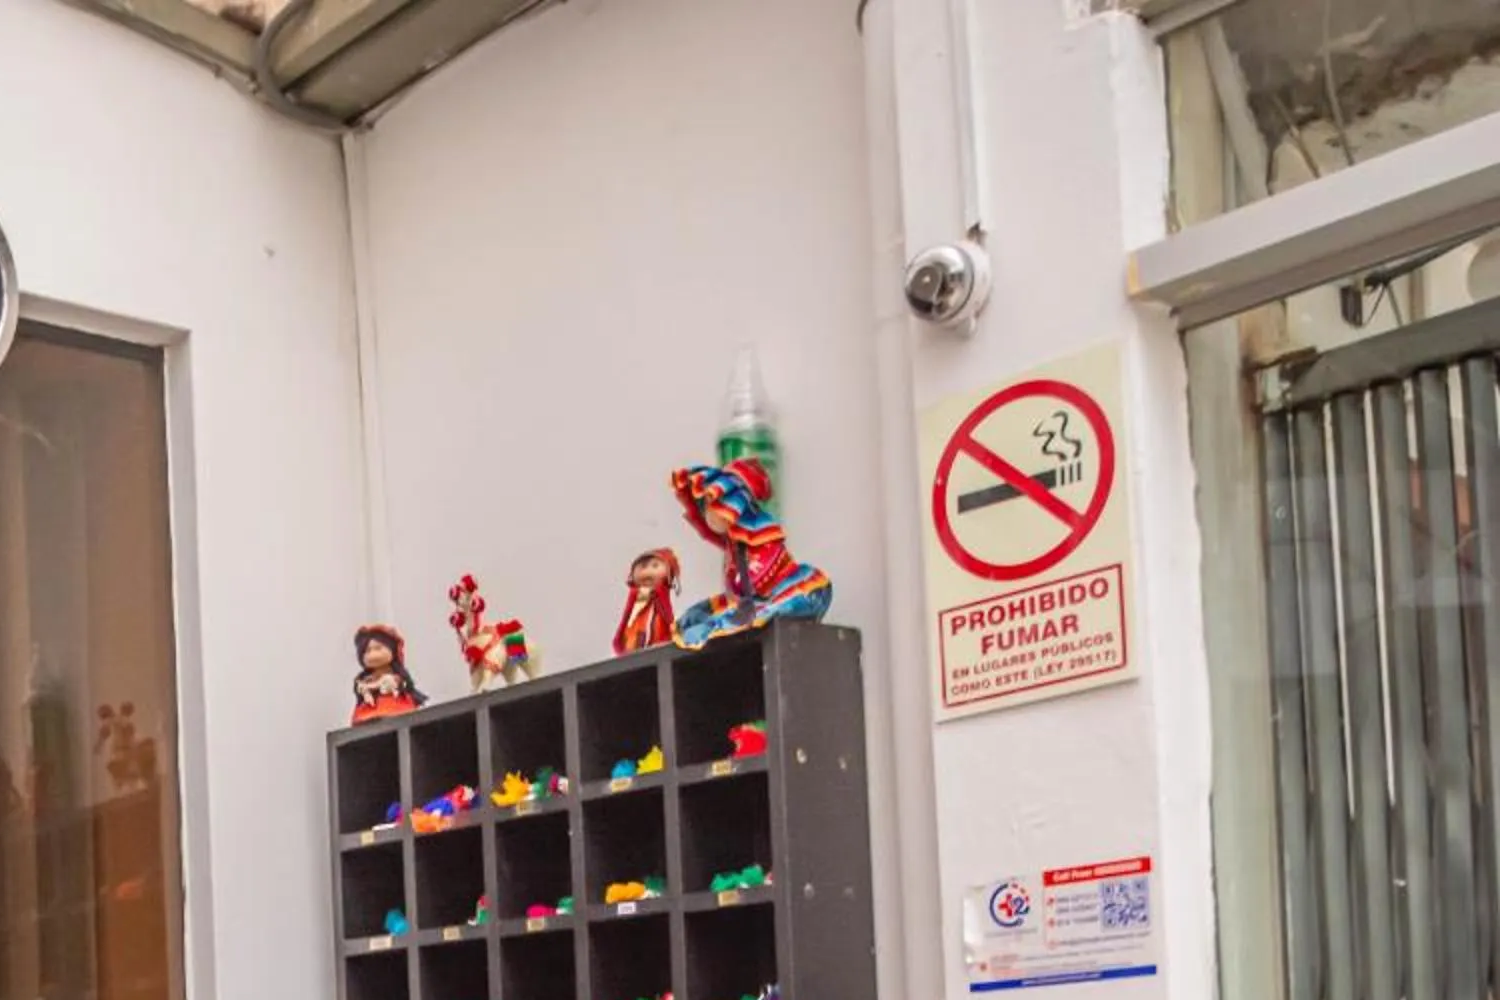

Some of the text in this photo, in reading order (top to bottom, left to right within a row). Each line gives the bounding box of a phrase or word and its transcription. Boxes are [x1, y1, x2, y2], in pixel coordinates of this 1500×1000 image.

[950, 577, 1109, 636] PROHIBIDO
[981, 614, 1080, 655] FUMAR
[950, 679, 991, 695] COMO
[995, 669, 1029, 687] ESTE
[1033, 660, 1064, 681] (LEY
[952, 668, 970, 680] EN
[973, 649, 1036, 676] LUGARES
